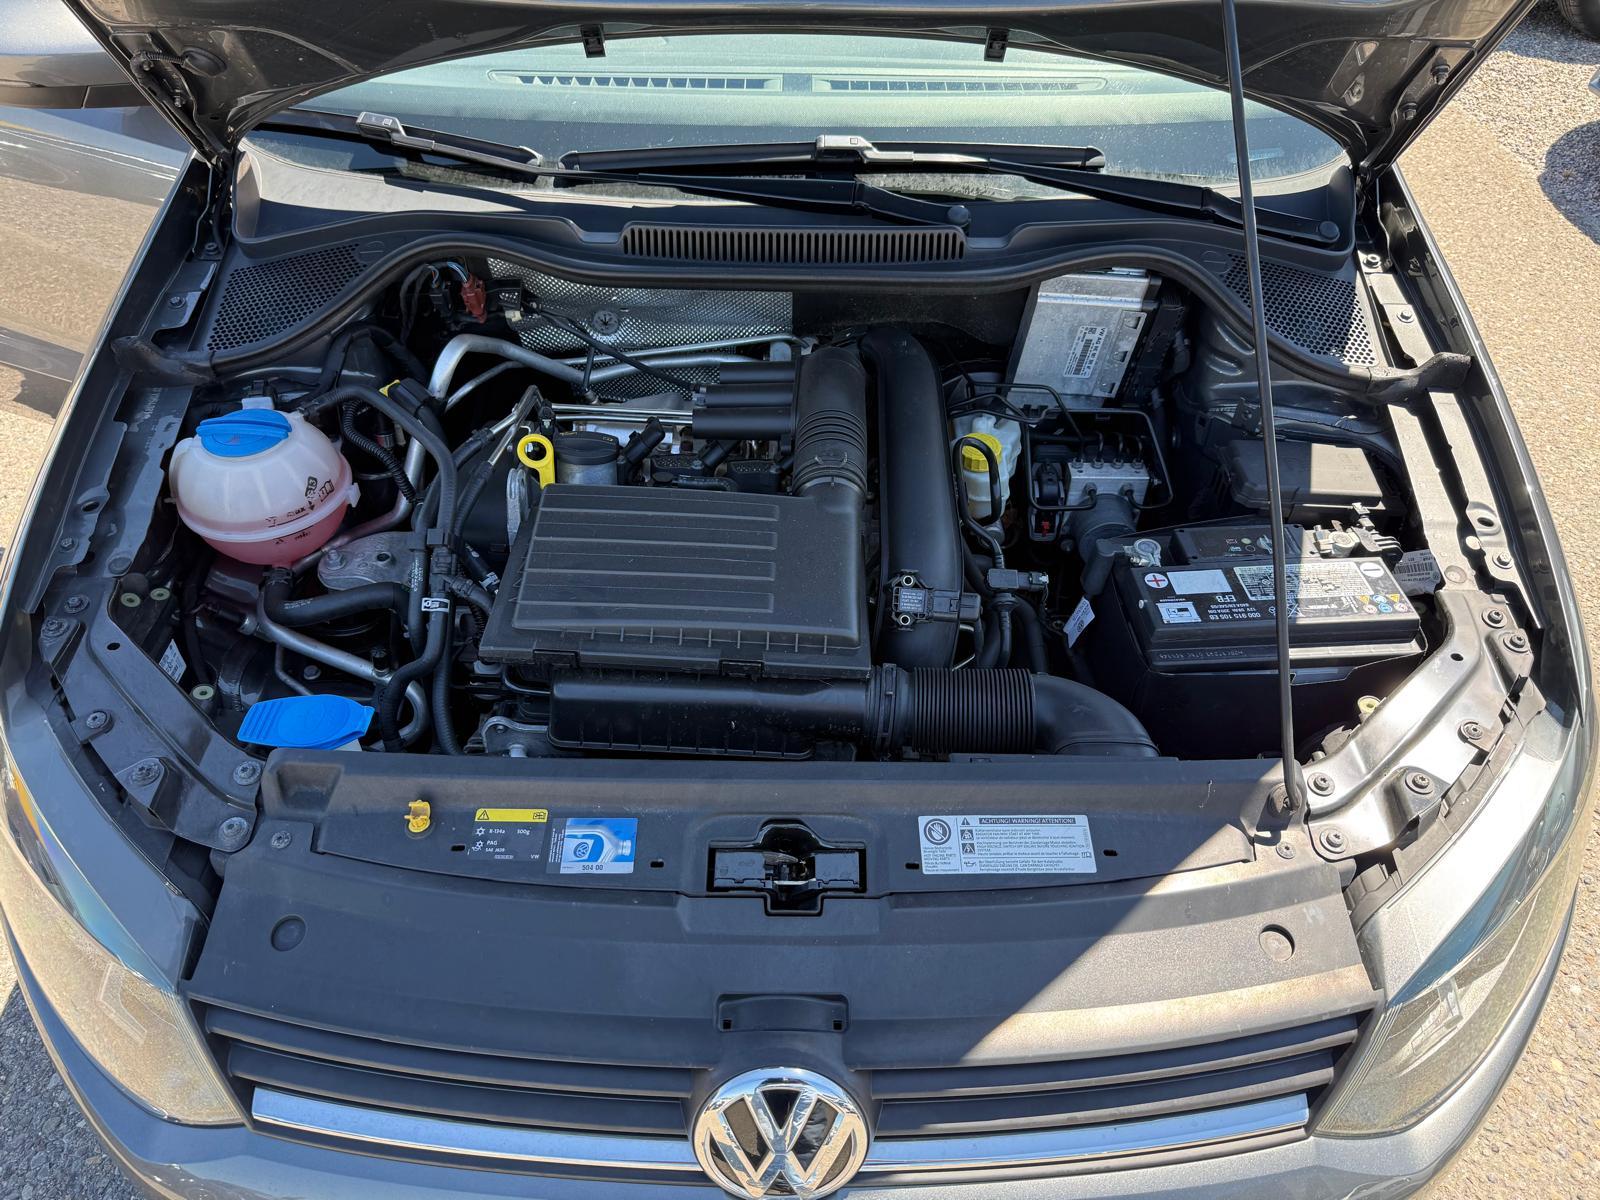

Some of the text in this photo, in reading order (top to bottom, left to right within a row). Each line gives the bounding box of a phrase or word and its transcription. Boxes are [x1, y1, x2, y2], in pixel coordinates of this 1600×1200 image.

[1216, 595, 1236, 603] EFB
[980, 817, 1074, 825] ACHTUNG! WARNING! ATTENTION!
[693, 1066, 870, 1199] VW
